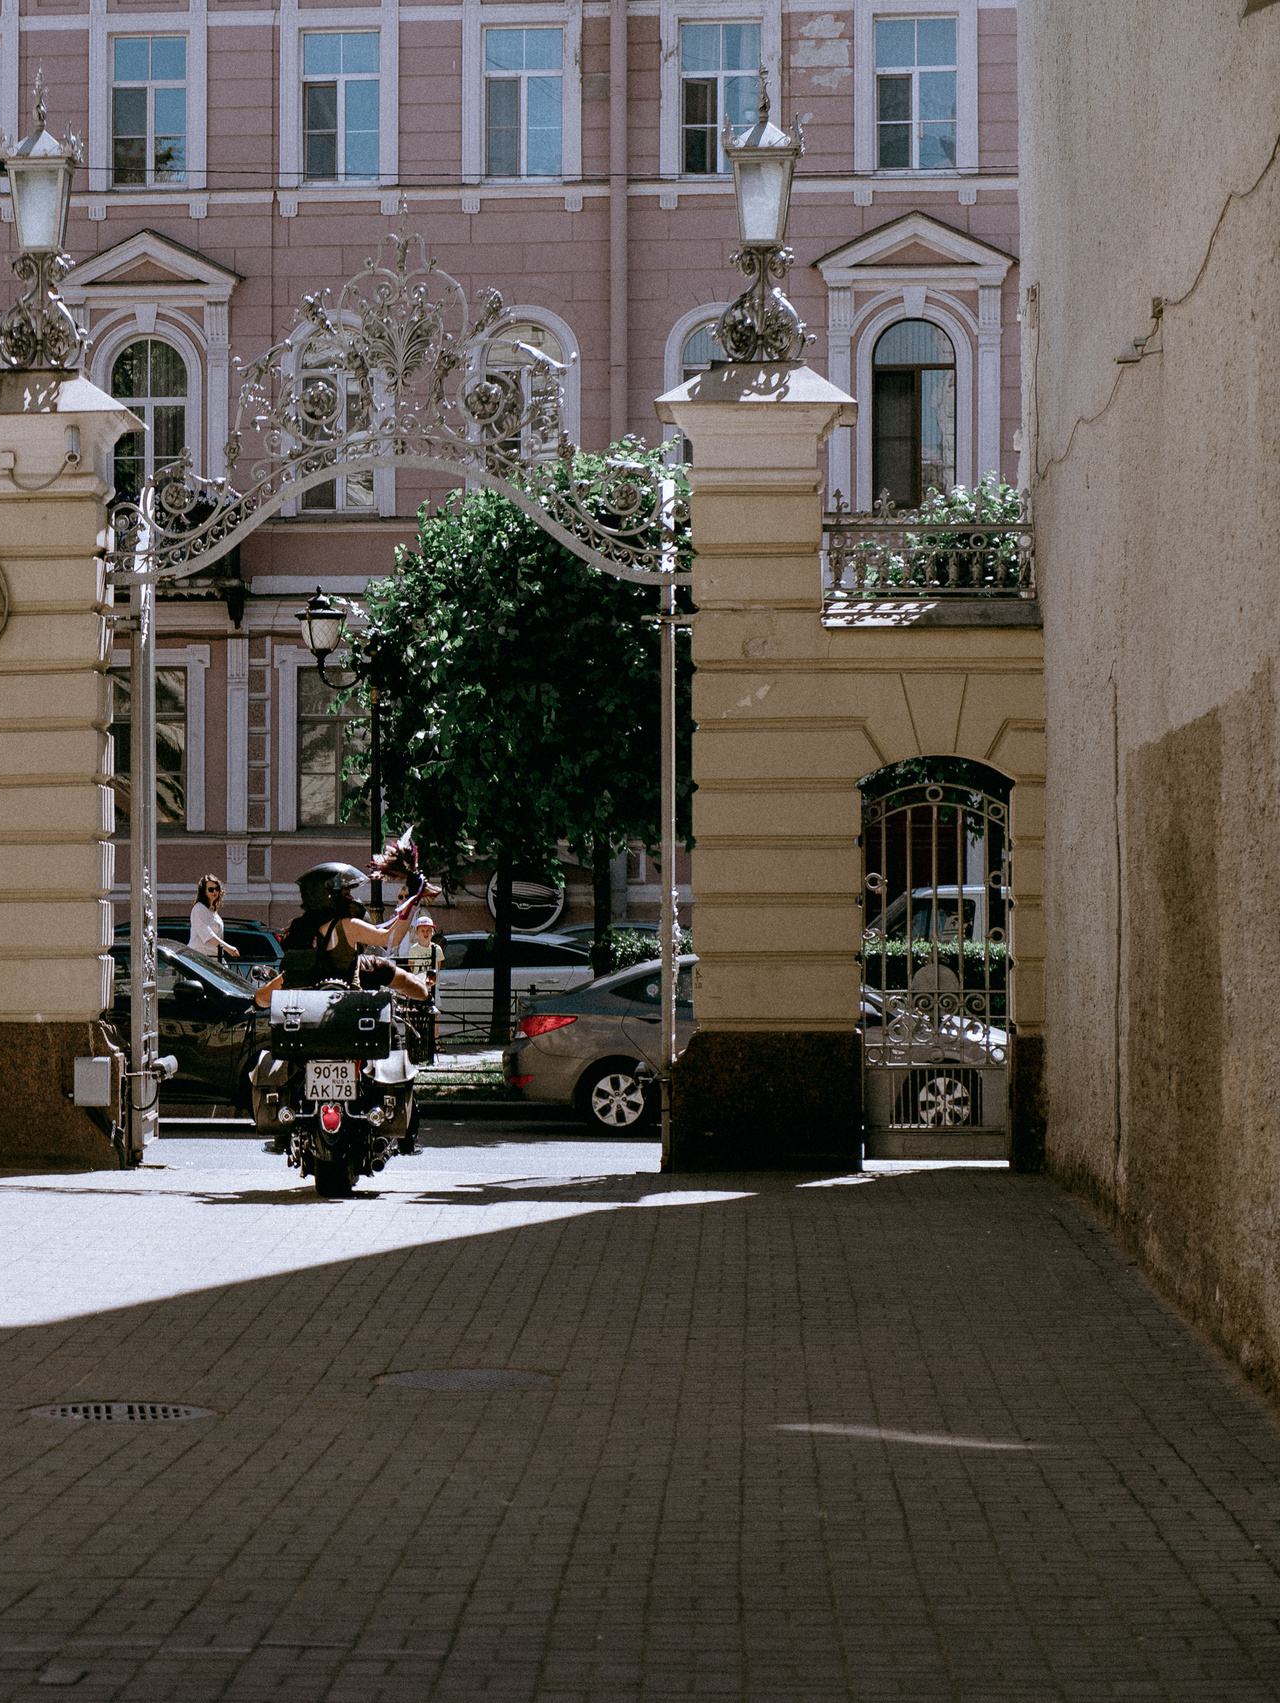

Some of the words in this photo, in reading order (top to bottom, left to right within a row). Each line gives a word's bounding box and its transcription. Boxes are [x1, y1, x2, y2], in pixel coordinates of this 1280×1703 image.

[314, 1066, 348, 1079] 9018
[310, 1085, 330, 1097] AK
[335, 1085, 352, 1097] 78
